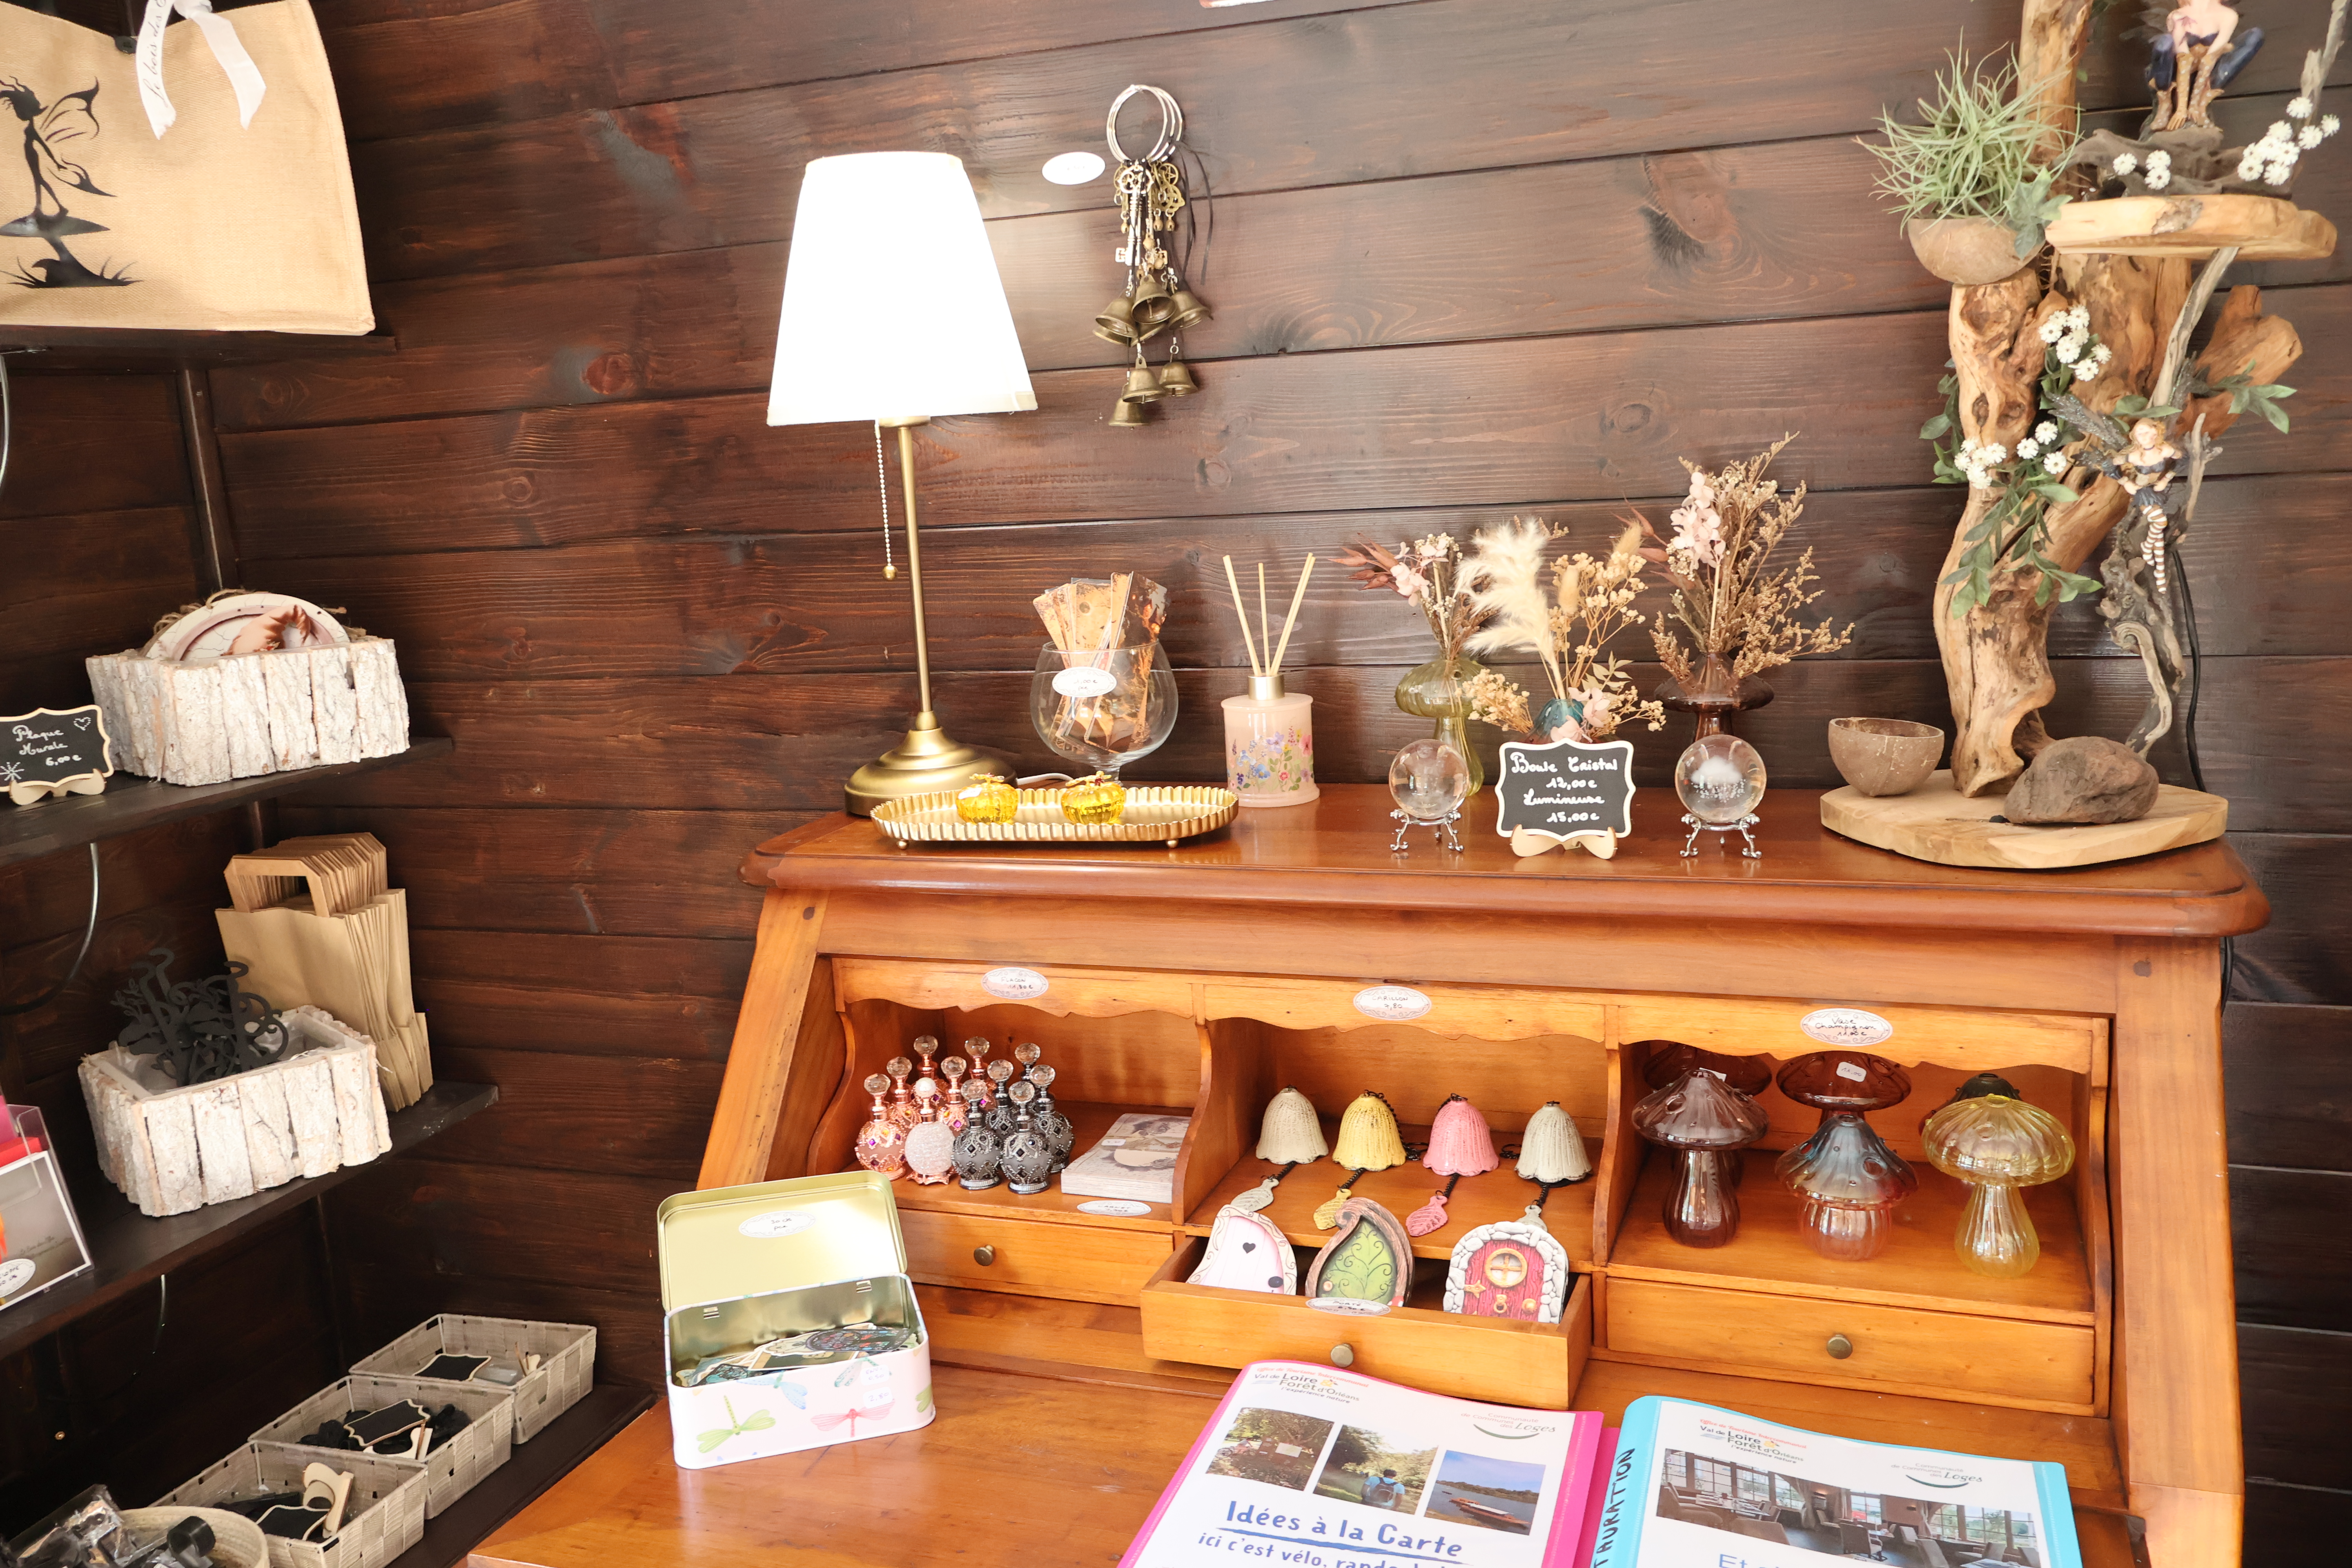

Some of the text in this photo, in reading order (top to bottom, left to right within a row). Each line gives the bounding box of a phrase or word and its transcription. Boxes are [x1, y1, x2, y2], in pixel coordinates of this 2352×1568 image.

[148, 15, 162, 37] des
[143, 44, 157, 74] bois
[12, 725, 64, 742] Plaque
[19, 742, 68, 755] Murale
[1510, 751, 1618, 773] Boule Cristal
[1523, 788, 1605, 806] Lumineuse
[1282, 1374, 1318, 1383] Loire
[1318, 1372, 1369, 1388] Intercommunal
[1279, 1380, 1359, 1401] Forêt d'Orléans
[1281, 1387, 1350, 1403] l'expérience nature
[1473, 1415, 1514, 1425] Communes
[1488, 1413, 1539, 1423] Communauté
[1514, 1423, 1556, 1432] Loges
[1728, 1425, 1756, 1436] Tourisme
[1758, 1434, 1807, 1448] Intercommunal
[1728, 1431, 1761, 1444] Loire
[1728, 1437, 1762, 1451] Forêt
[1774, 1455, 1797, 1464] nature
[1902, 1465, 1941, 1474] Communes
[1915, 1463, 1964, 1472] Communauté
[1944, 1472, 1982, 1482] Loges
[1226, 1500, 1463, 1557] Idées à la Carte
[1198, 1532, 1222, 1548] ici
[1228, 1538, 1274, 1558] c'est
[1282, 1548, 1327, 1568] vélo,
[1719, 1553, 1748, 1568] Et
